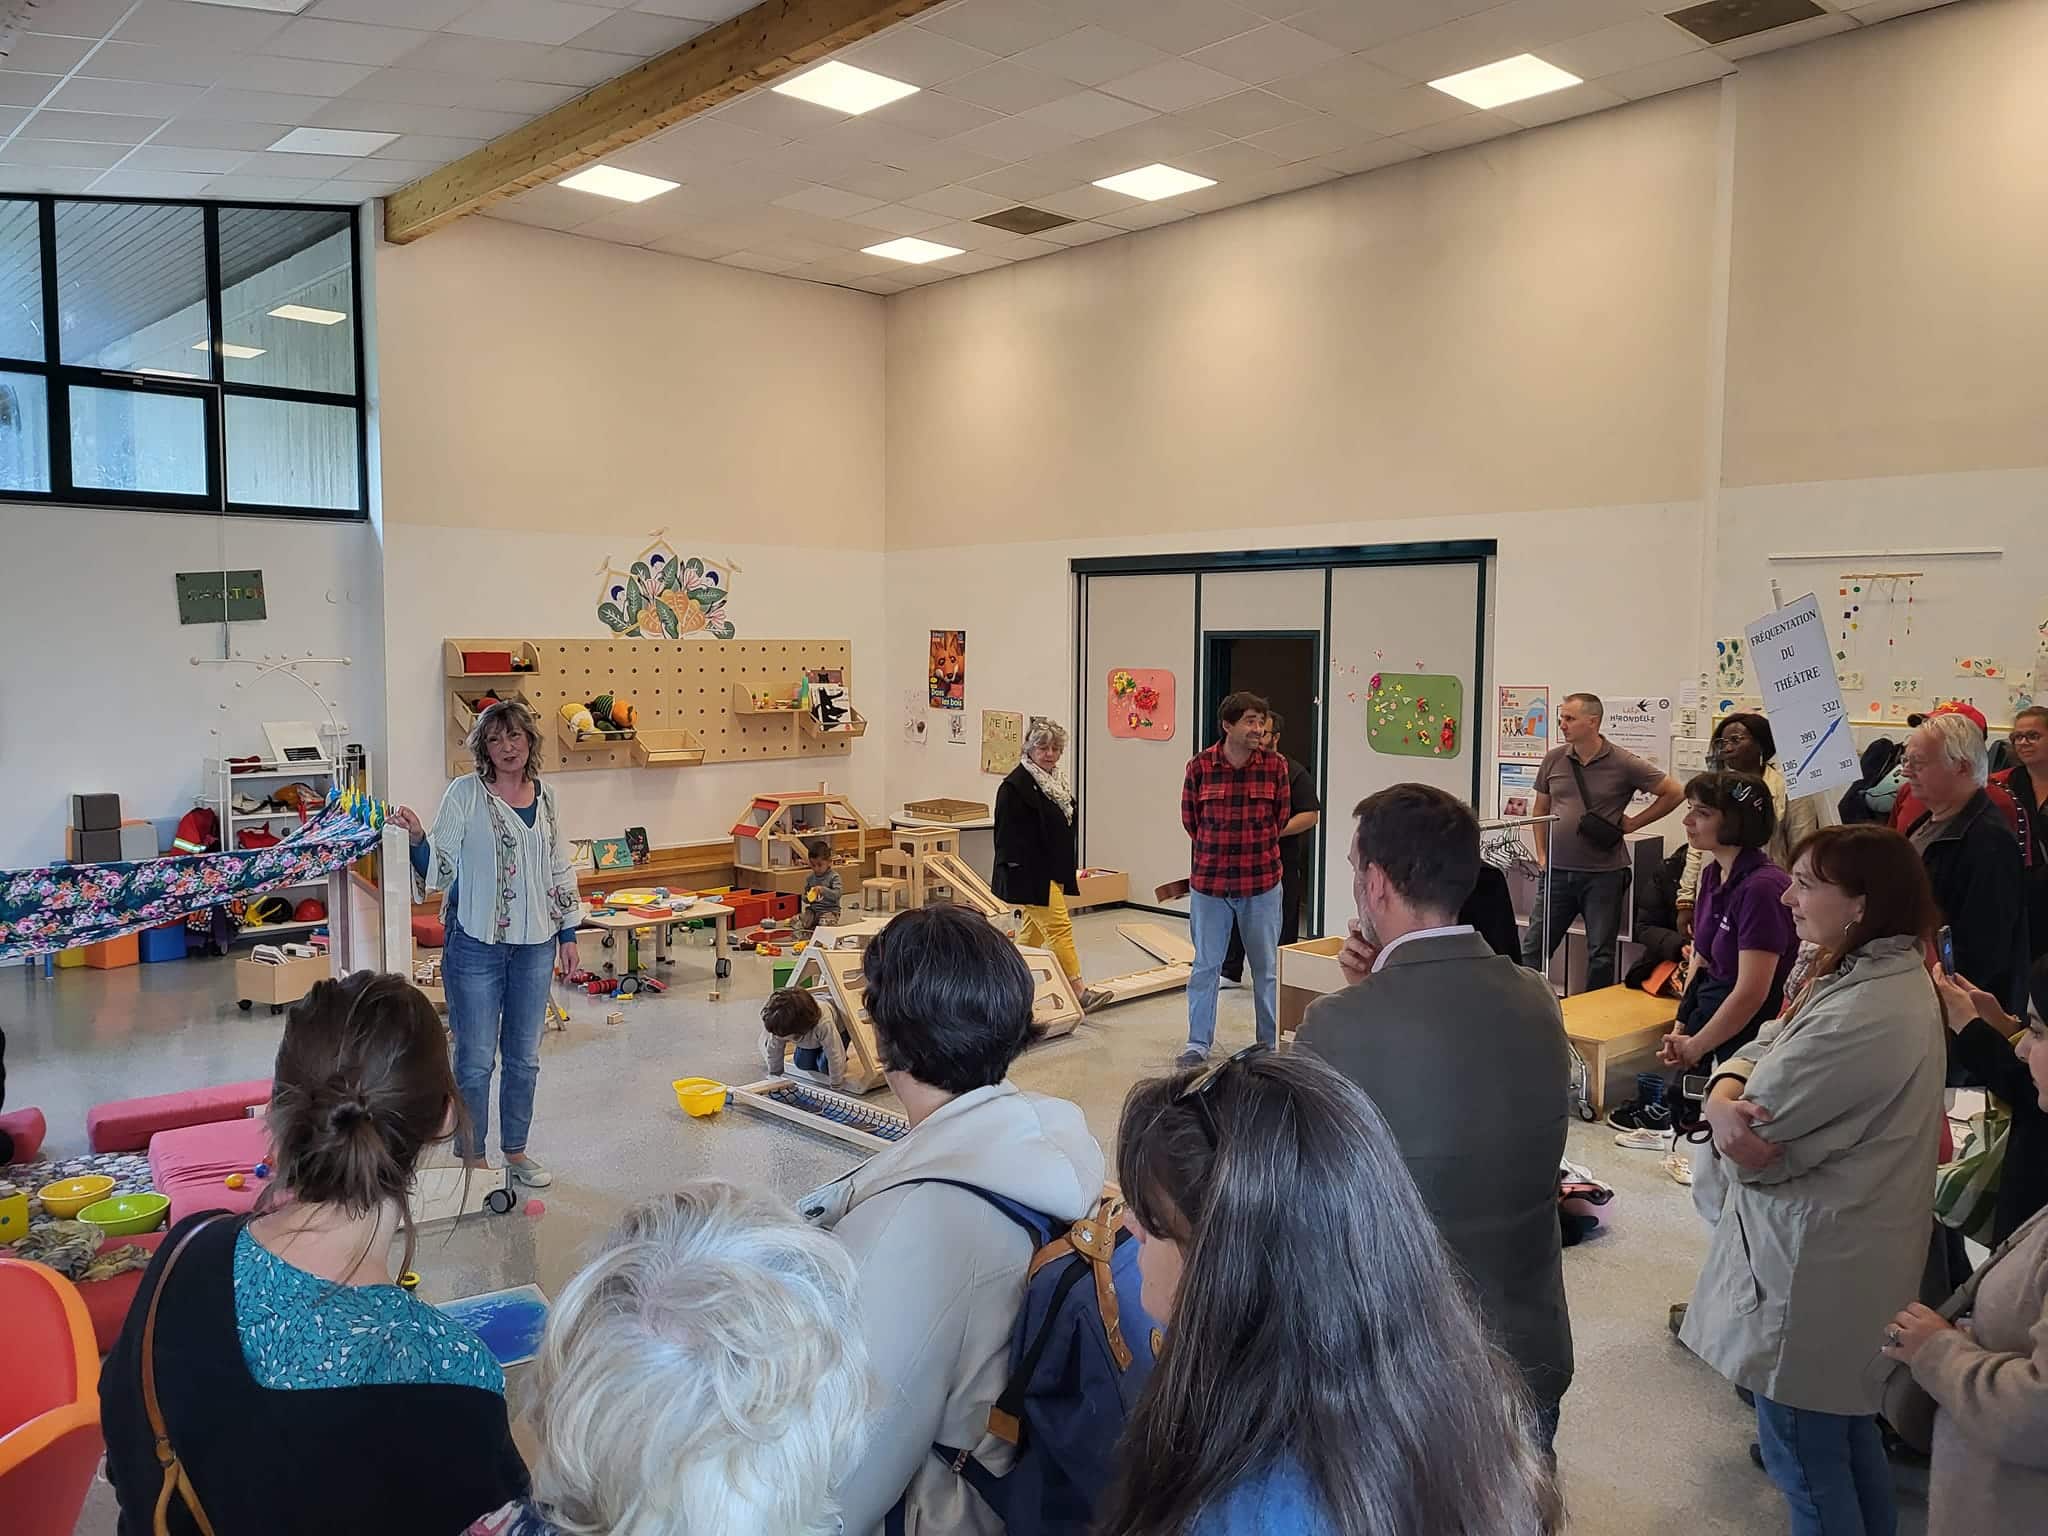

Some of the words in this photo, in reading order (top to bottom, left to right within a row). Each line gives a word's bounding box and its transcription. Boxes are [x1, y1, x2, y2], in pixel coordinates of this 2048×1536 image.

[1750, 609, 1817, 647] FRÉQUENTATION
[1781, 645, 1795, 661] DU
[1773, 666, 1821, 693] THÉÂTRE
[1821, 699, 1841, 714] 5321
